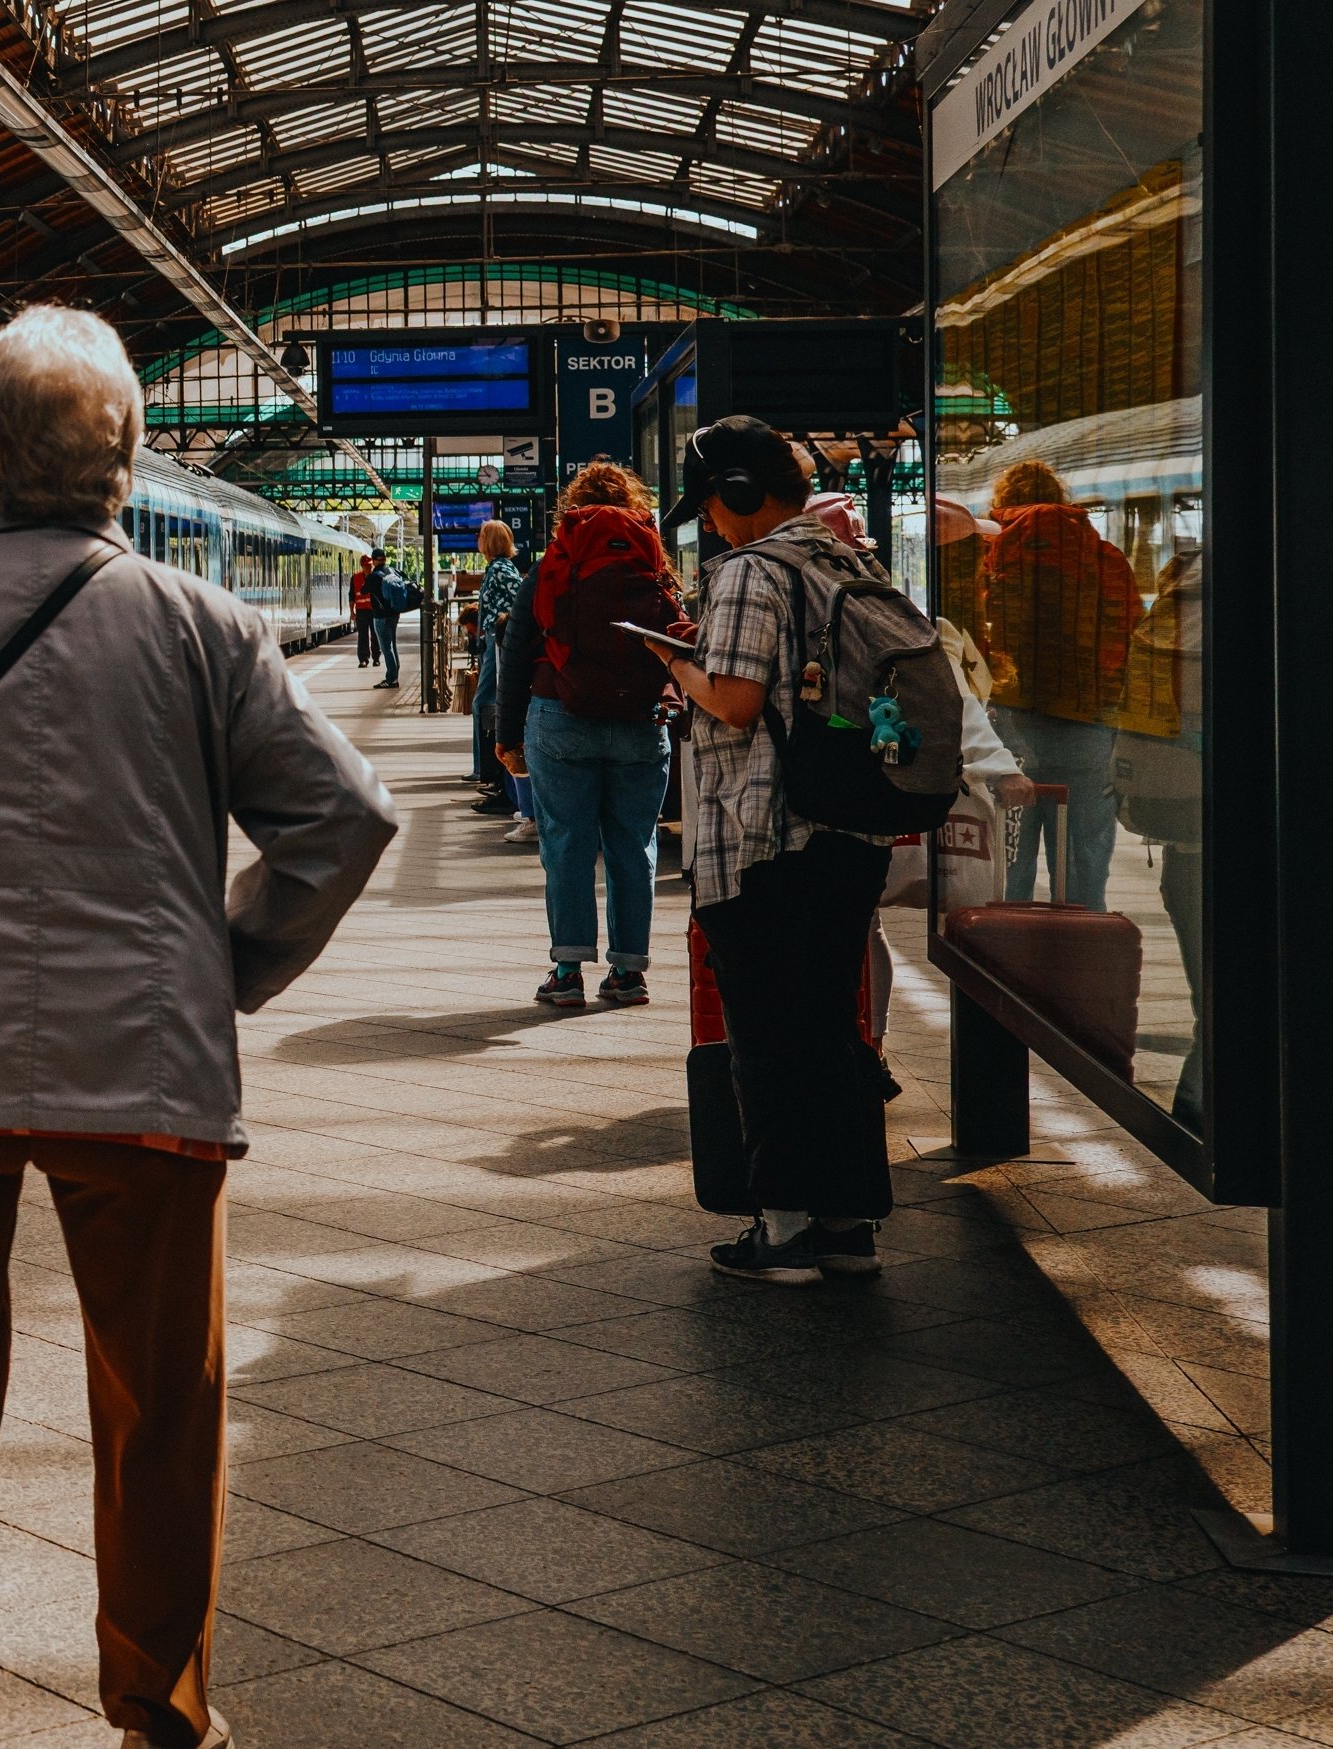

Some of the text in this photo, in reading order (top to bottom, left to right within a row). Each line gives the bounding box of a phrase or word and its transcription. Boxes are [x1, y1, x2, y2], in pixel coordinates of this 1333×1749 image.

[975, 21, 1042, 137] WROCŁAW
[332, 350, 356, 364] 11:10
[369, 349, 411, 364] Gdynia
[566, 355, 636, 371] SEKTOR
[589, 387, 617, 420] B
[511, 517, 522, 529] B
